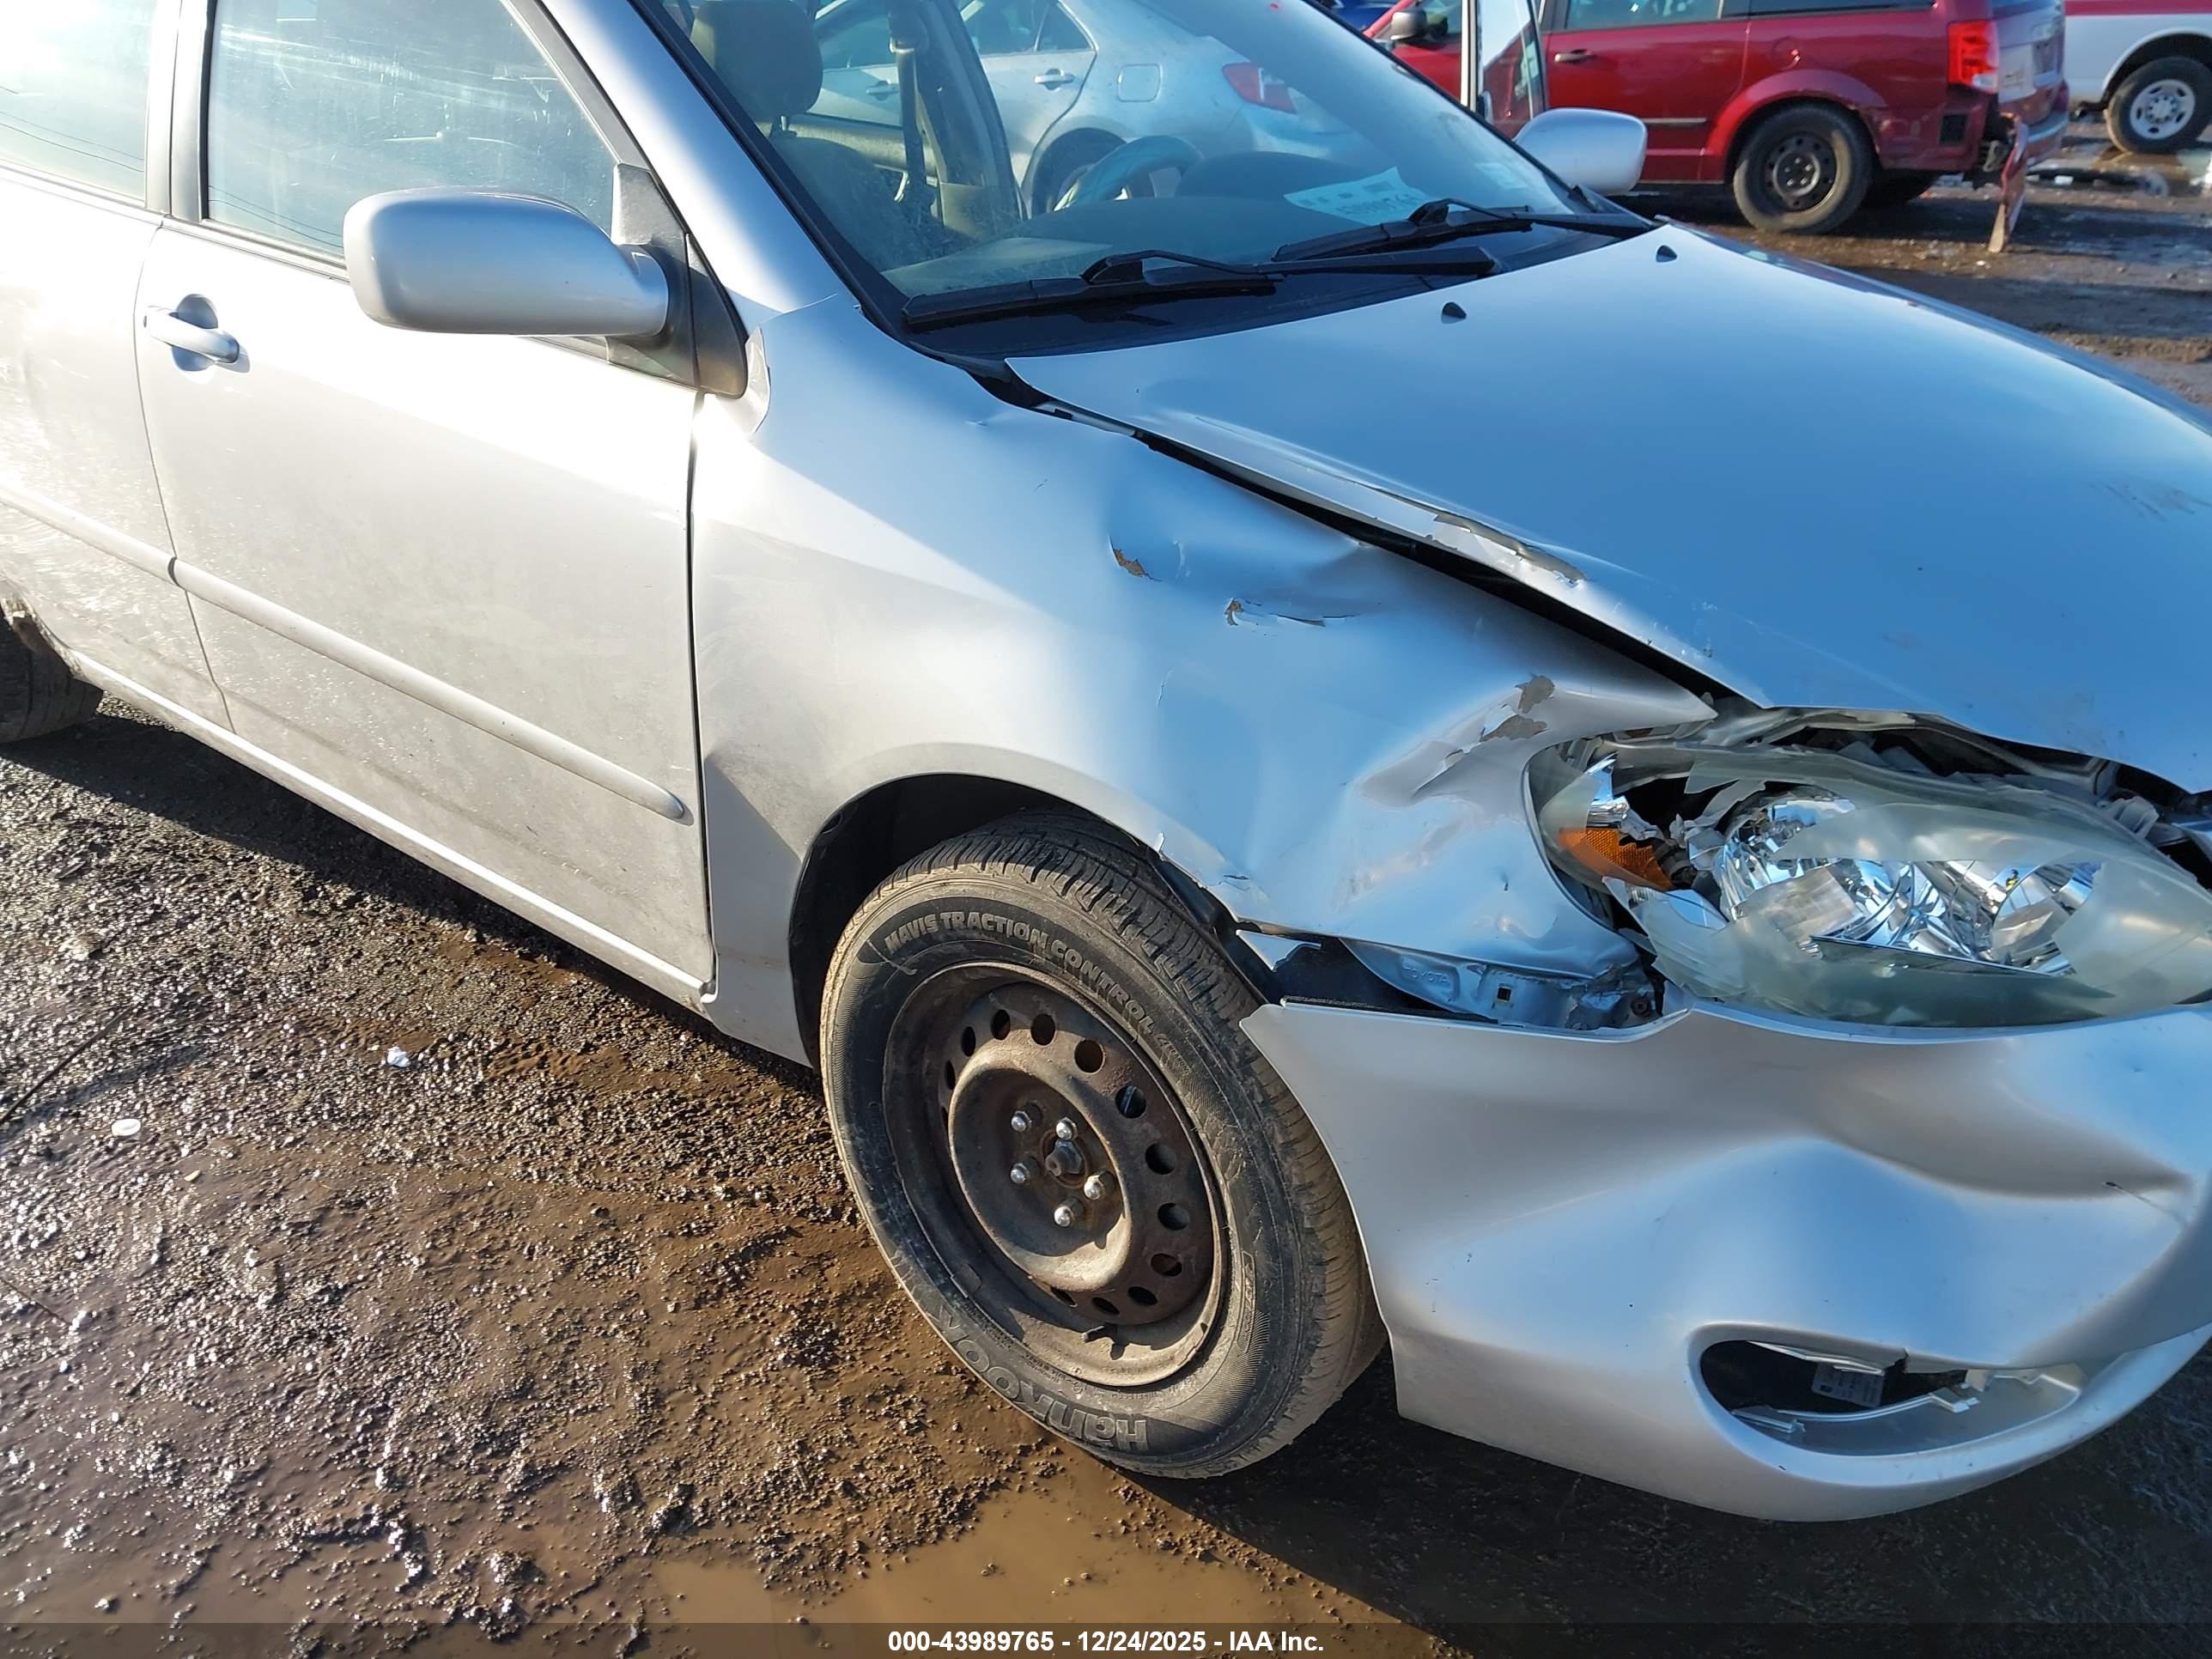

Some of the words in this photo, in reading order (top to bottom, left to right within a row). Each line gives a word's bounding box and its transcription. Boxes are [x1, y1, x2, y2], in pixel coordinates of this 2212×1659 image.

[884, 914, 939, 955] MAVIS
[939, 911, 1048, 949] TRACTION
[1051, 939, 1155, 1035] CONTROL
